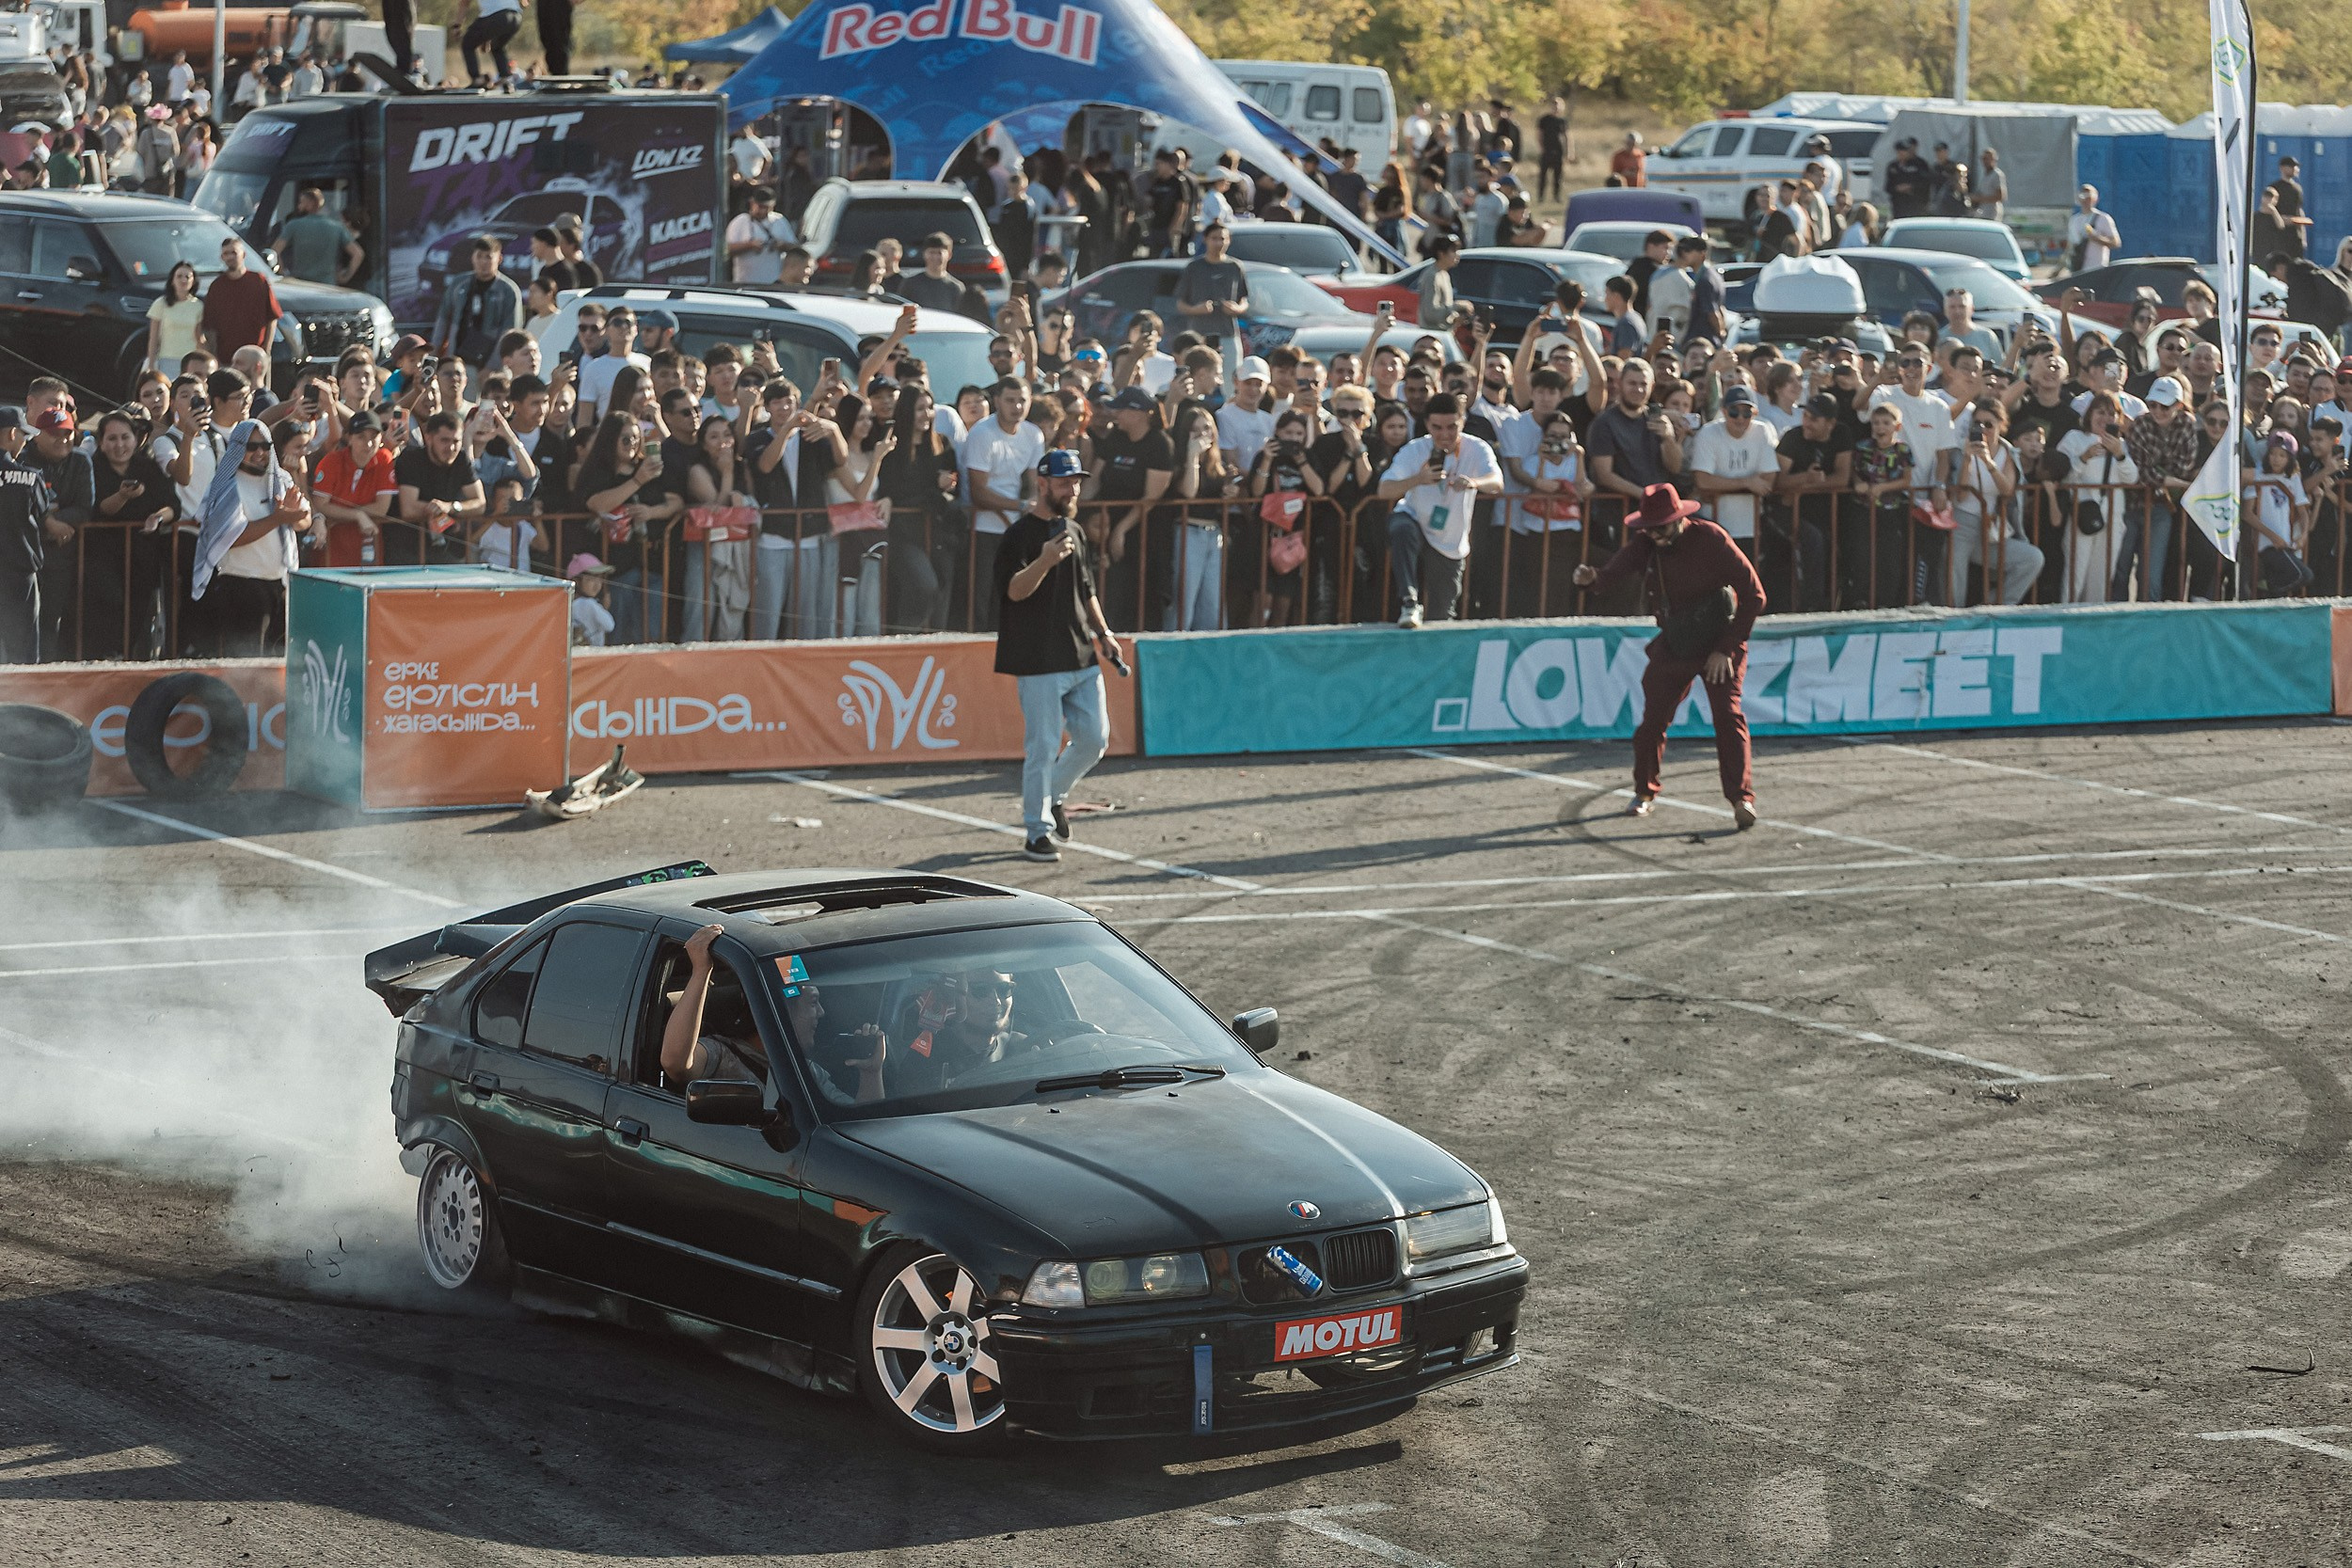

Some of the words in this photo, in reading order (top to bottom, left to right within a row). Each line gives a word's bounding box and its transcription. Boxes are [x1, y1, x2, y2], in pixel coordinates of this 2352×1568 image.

[818, 0, 953, 61] Red
[959, 0, 1103, 66] Bull
[408, 111, 585, 174] DRIFT
[631, 148, 677, 172] LOW
[675, 145, 705, 166] KZ
[649, 210, 713, 245] КАССА
[1467, 626, 2063, 732] LOWZMEET
[1280, 1311, 1396, 1356] MOTUL
